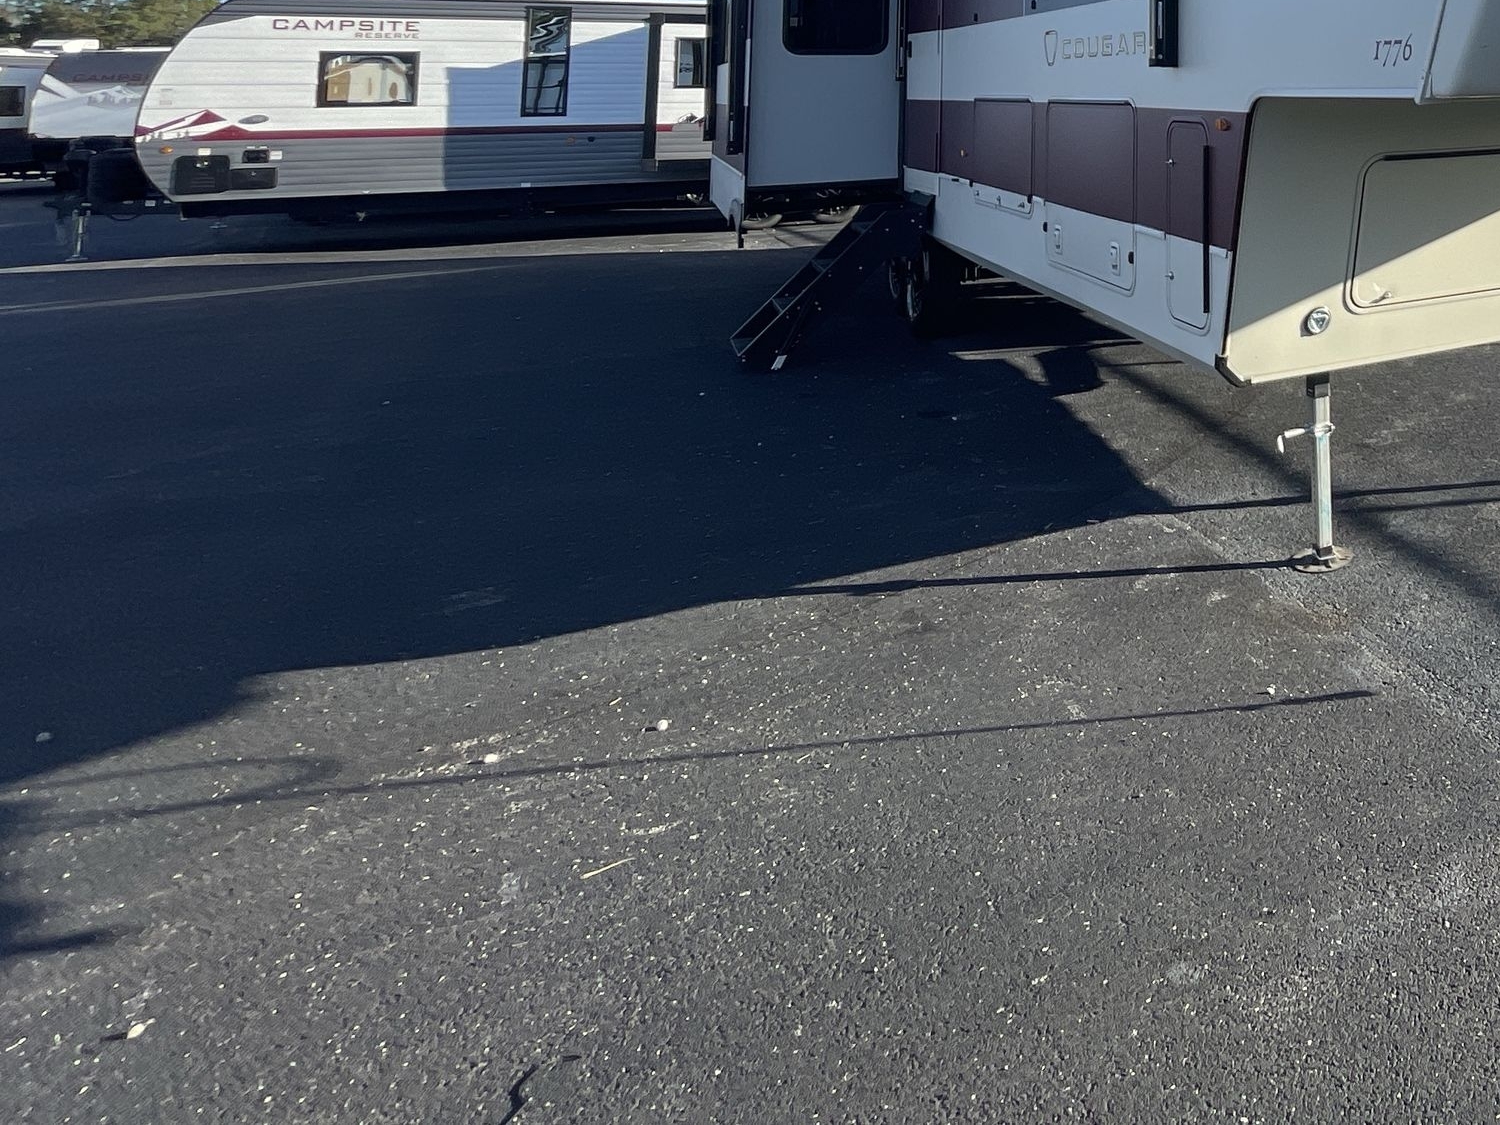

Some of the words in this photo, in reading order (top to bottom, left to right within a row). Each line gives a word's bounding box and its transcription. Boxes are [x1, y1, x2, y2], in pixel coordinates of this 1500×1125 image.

[272, 18, 420, 32] CAMPSITE
[354, 31, 420, 39] RESERVE
[1061, 31, 1146, 59] COUGAR
[1373, 32, 1412, 67] 1776
